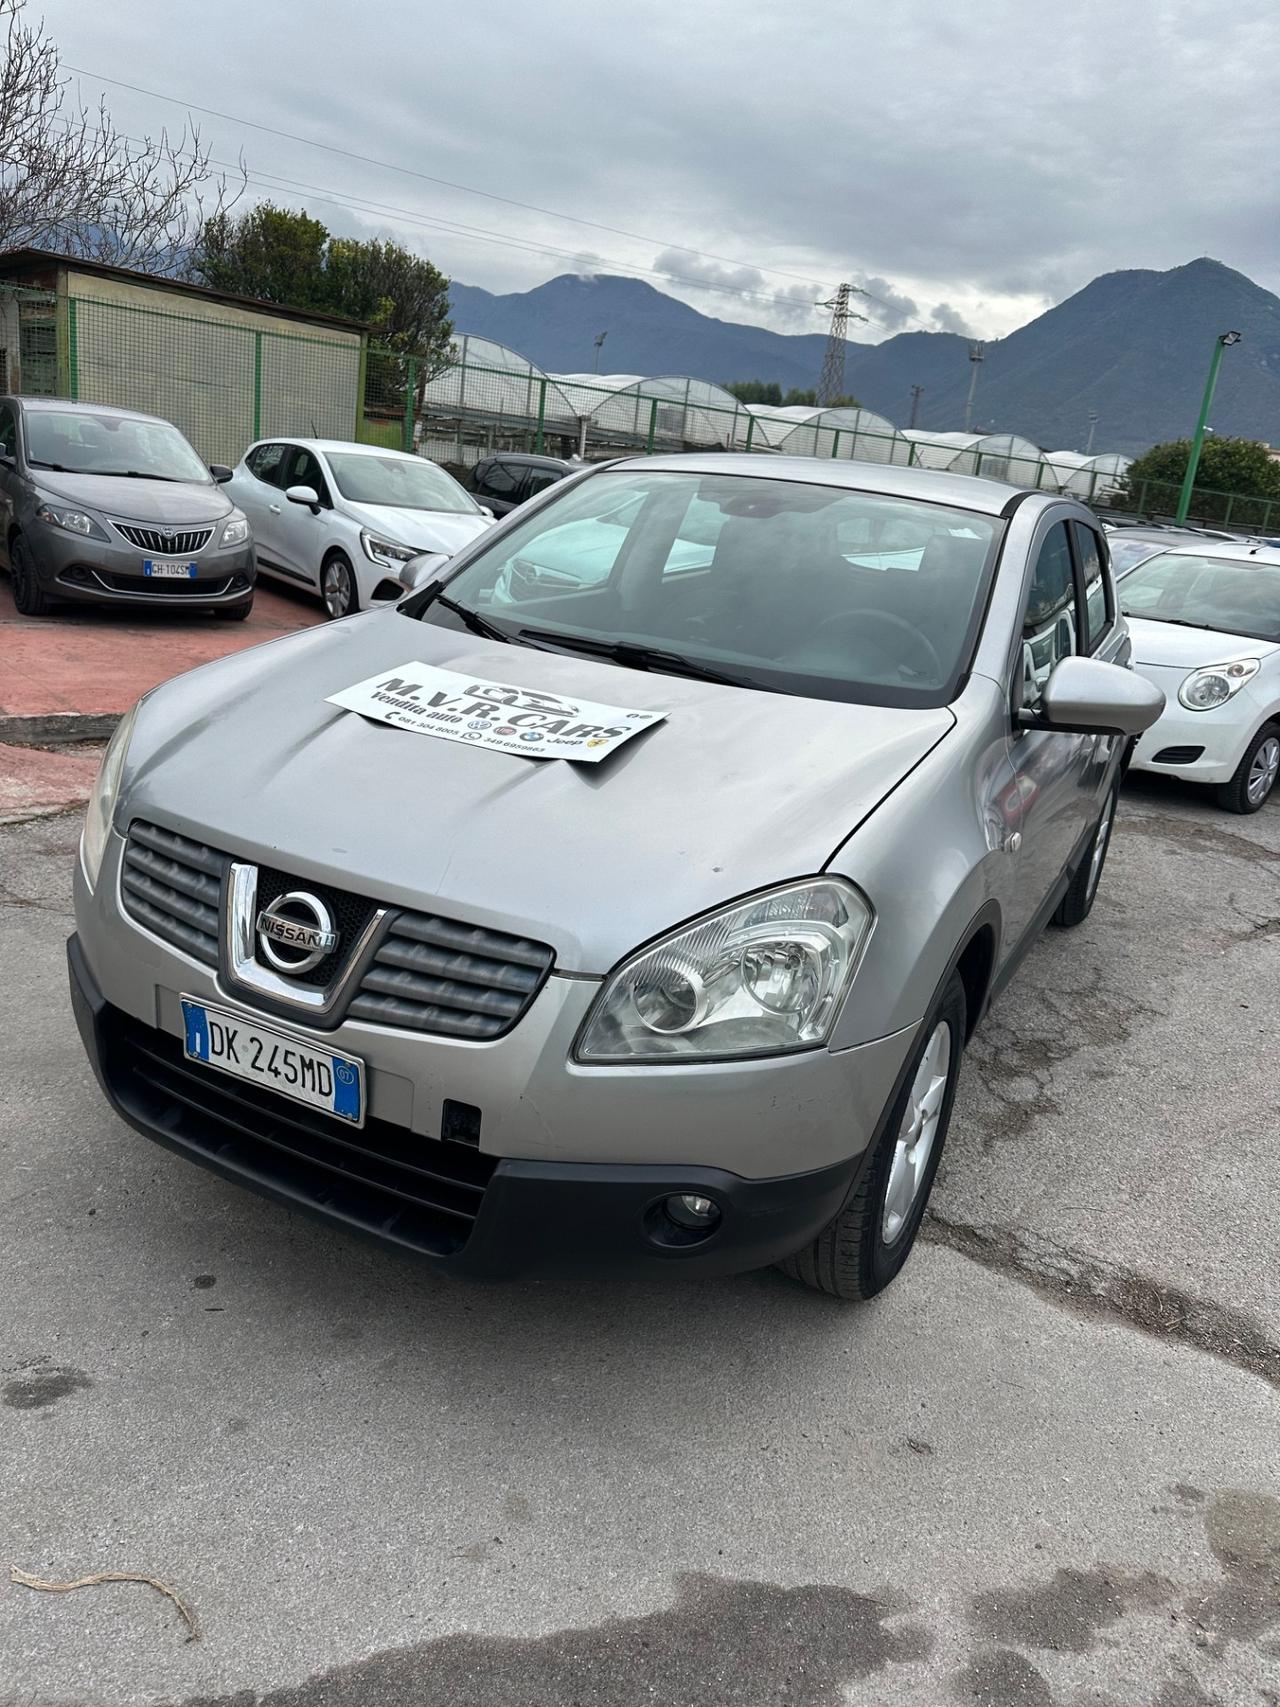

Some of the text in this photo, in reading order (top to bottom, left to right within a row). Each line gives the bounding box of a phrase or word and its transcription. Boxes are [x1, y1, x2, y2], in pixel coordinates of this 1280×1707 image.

[370, 691, 463, 723] Vendita auto
[547, 738, 584, 746] Jeep
[260, 917, 322, 948] NISSAN
[209, 1021, 333, 1097] DK 245MD
